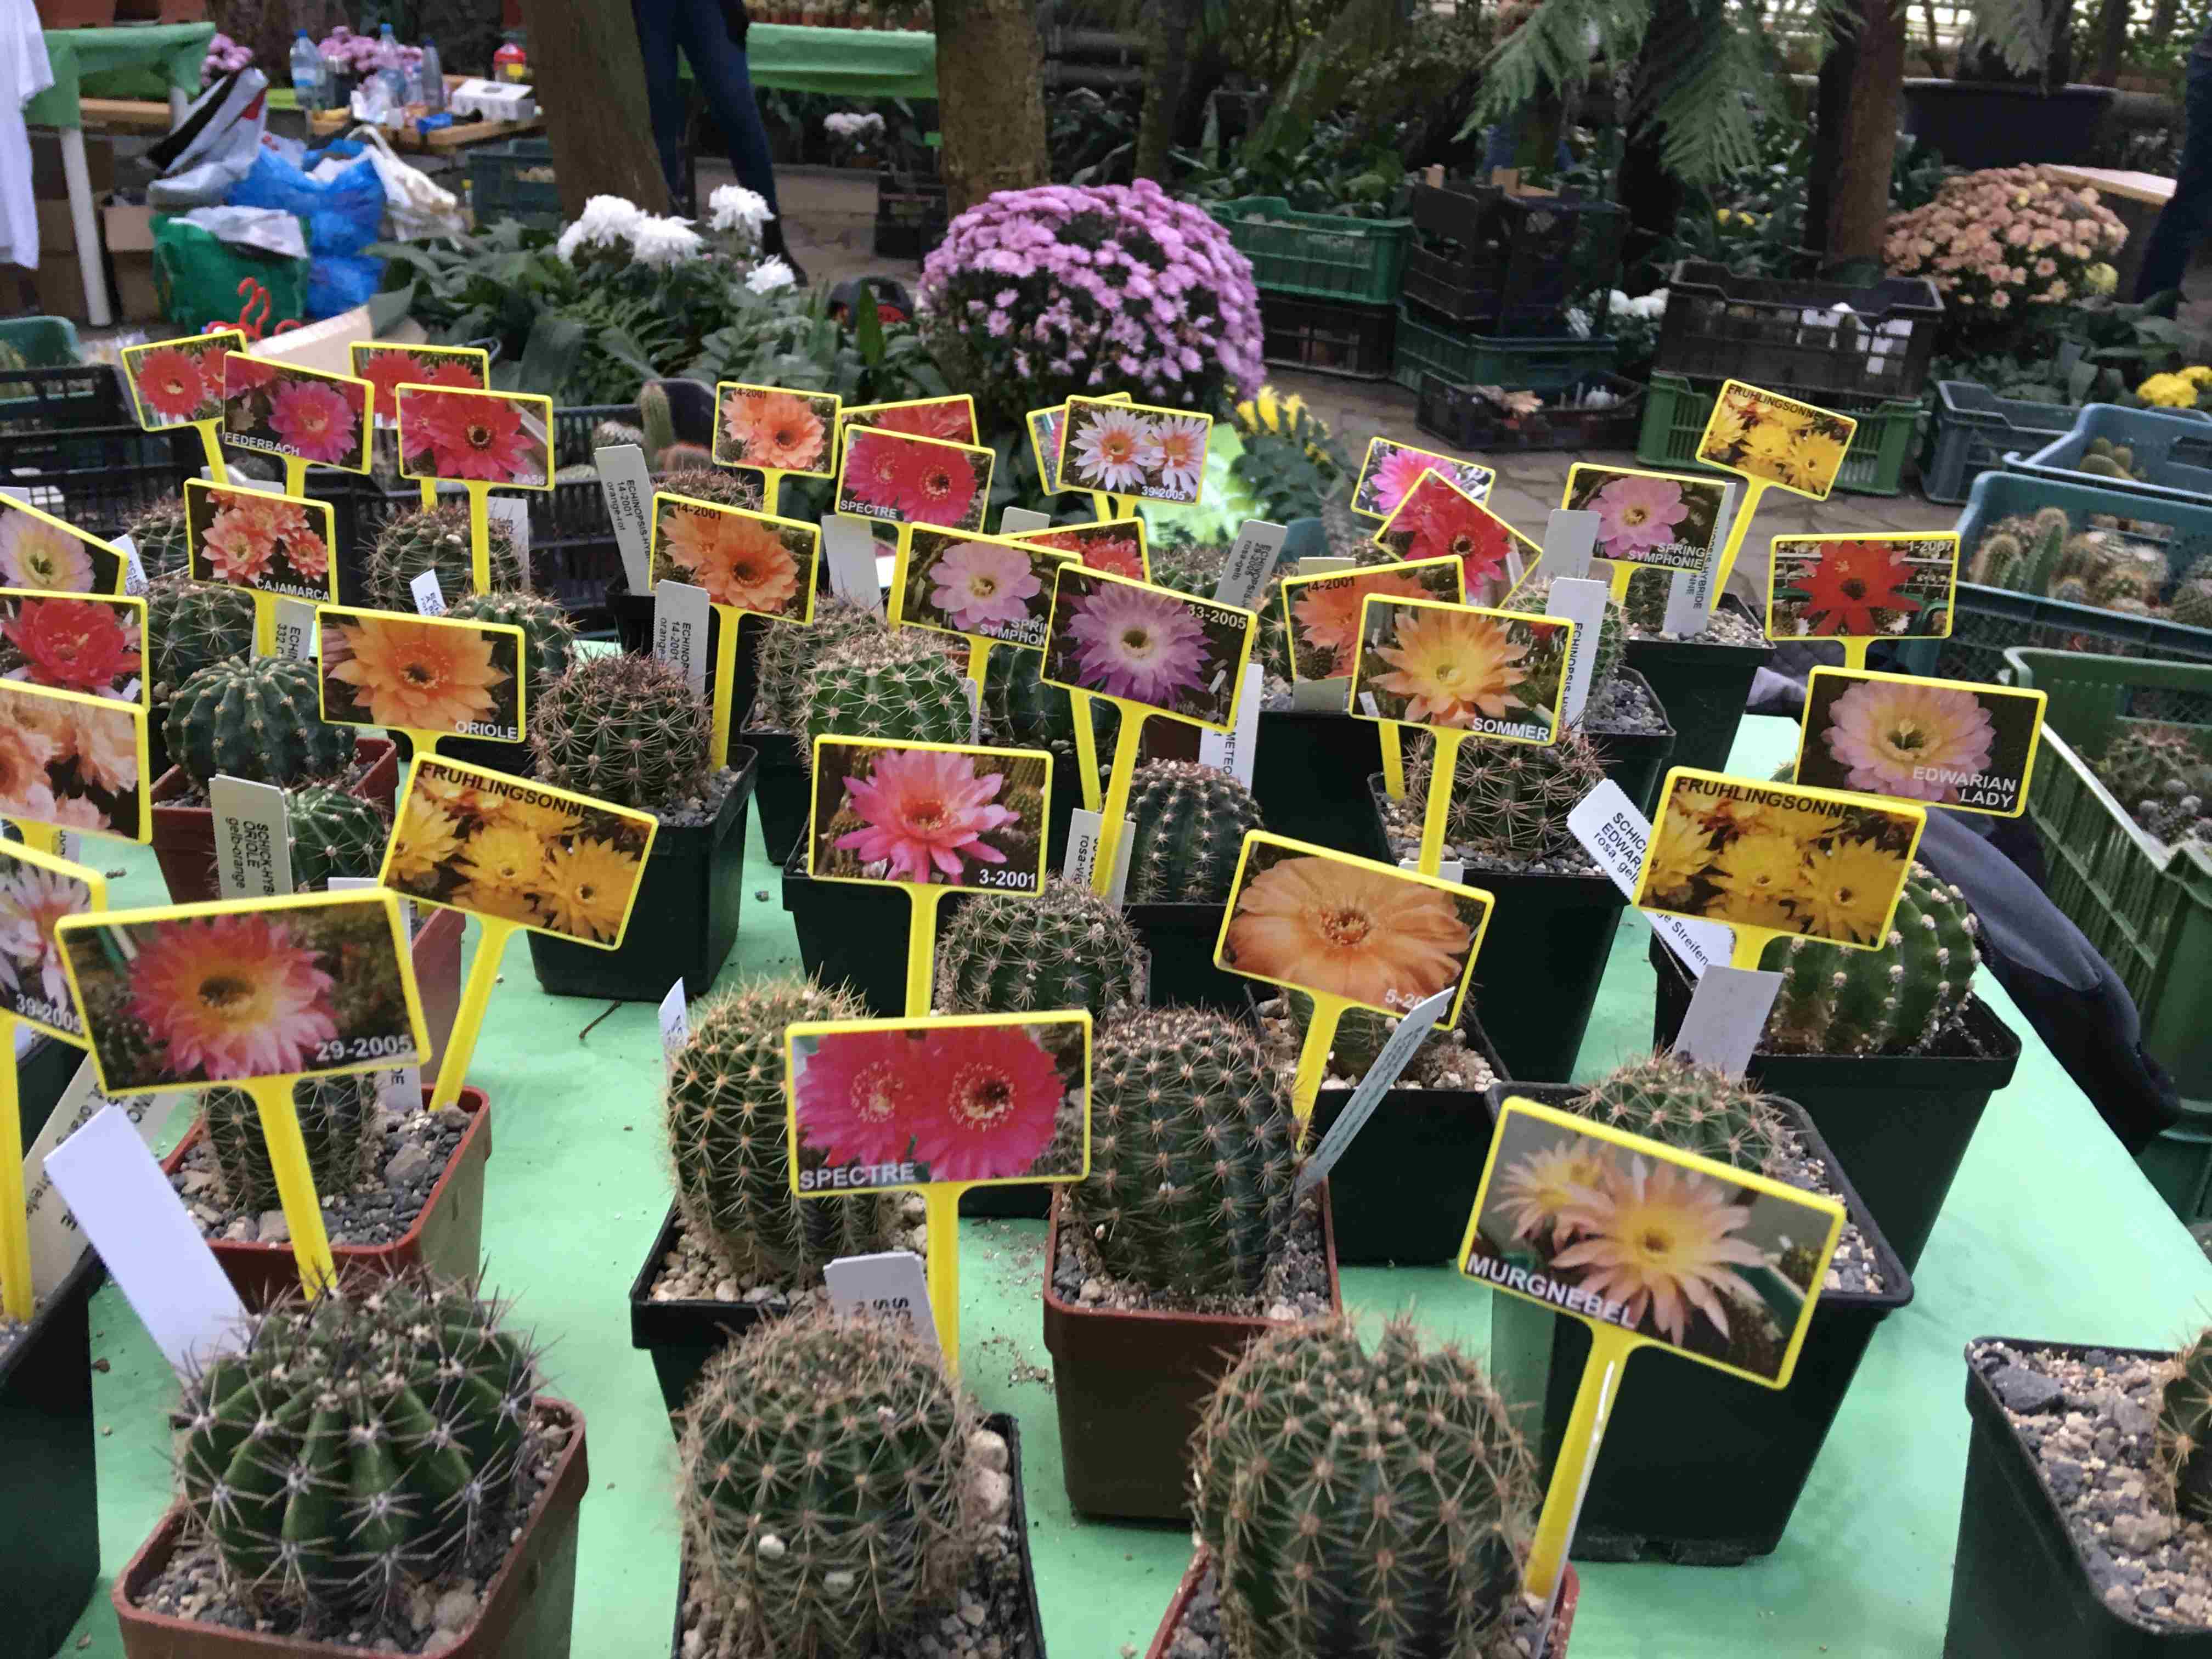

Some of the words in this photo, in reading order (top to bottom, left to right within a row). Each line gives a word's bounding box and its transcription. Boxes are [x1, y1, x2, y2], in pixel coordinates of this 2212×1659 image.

[733, 388, 768, 399] 14-2001
[224, 432, 300, 456] FEDERBACH
[617, 481, 633, 516] 14-2001
[1141, 486, 1186, 500] 39-2005
[676, 501, 722, 520] 14-2001
[840, 500, 898, 518] SPECTRE
[1627, 550, 1703, 569] SYMPHONIE
[1657, 542, 1706, 557] SPRING
[255, 579, 330, 602] CAJAMARCA
[1307, 576, 1355, 592] 14-2001
[1188, 604, 1247, 630] 33-2005
[455, 720, 518, 740] ORIOLE
[1473, 718, 1549, 741] SOMMER
[1913, 766, 2017, 792] EDWARIAN
[1960, 789, 2013, 808] LADY
[243, 821, 260, 868] ORIOLE
[1613, 812, 1646, 853] SCHIC
[225, 817, 245, 889] gelb-orange
[257, 823, 275, 895] SCHICK-HYB
[1594, 832, 1616, 862] rosa,
[979, 868, 1036, 888] 3-2001
[1672, 922, 1709, 966] Streifen
[315, 1034, 412, 1062] 29-2005
[800, 1161, 915, 1190] SPECTRE
[1466, 1252, 1637, 1329] MURGNEBEL
